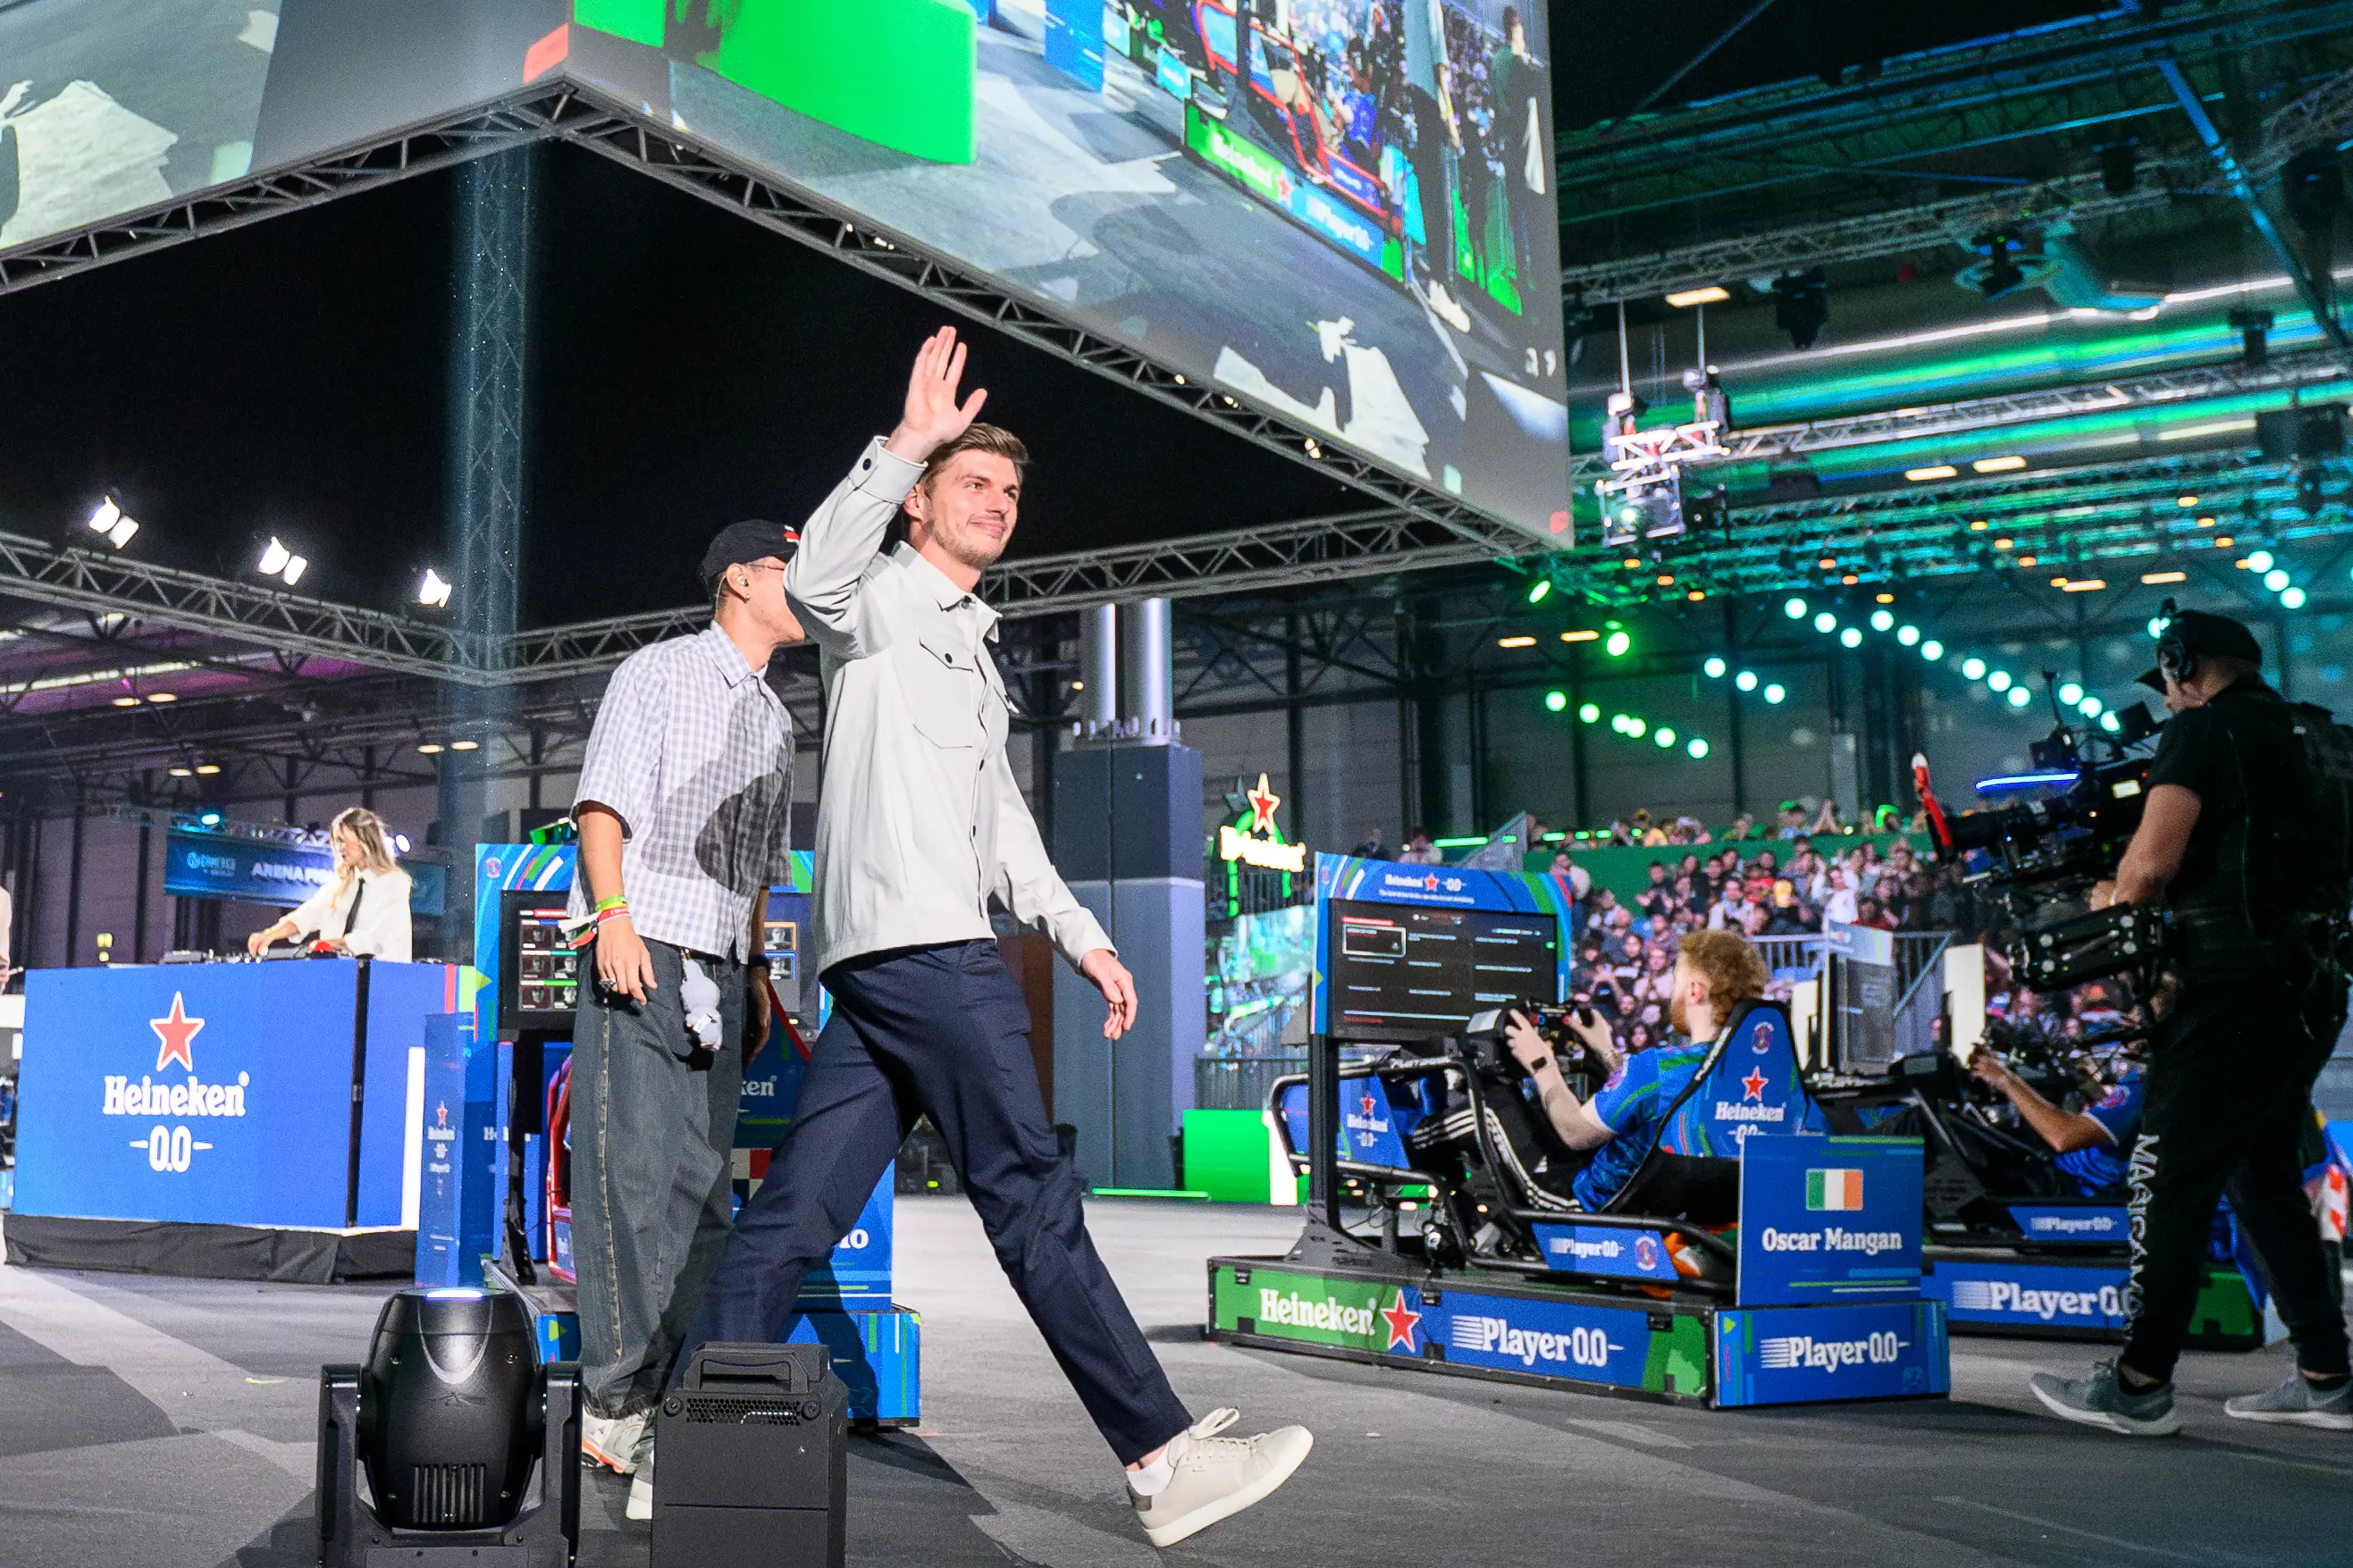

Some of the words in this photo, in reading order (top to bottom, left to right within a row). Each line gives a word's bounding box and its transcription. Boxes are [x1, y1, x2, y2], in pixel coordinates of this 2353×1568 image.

[251, 860, 307, 882] ARENA
[103, 1075, 246, 1117] Heineken
[1714, 1100, 1786, 1122] Heineken
[148, 1125, 192, 1173] 0.0
[1761, 1227, 1821, 1252] Oscar
[1824, 1227, 1903, 1256] Mangan
[1259, 1287, 1375, 1337] Heineken
[1988, 1281, 2098, 1321] Player
[1480, 1314, 1571, 1366] Player
[1788, 1336, 1869, 1374] Player
